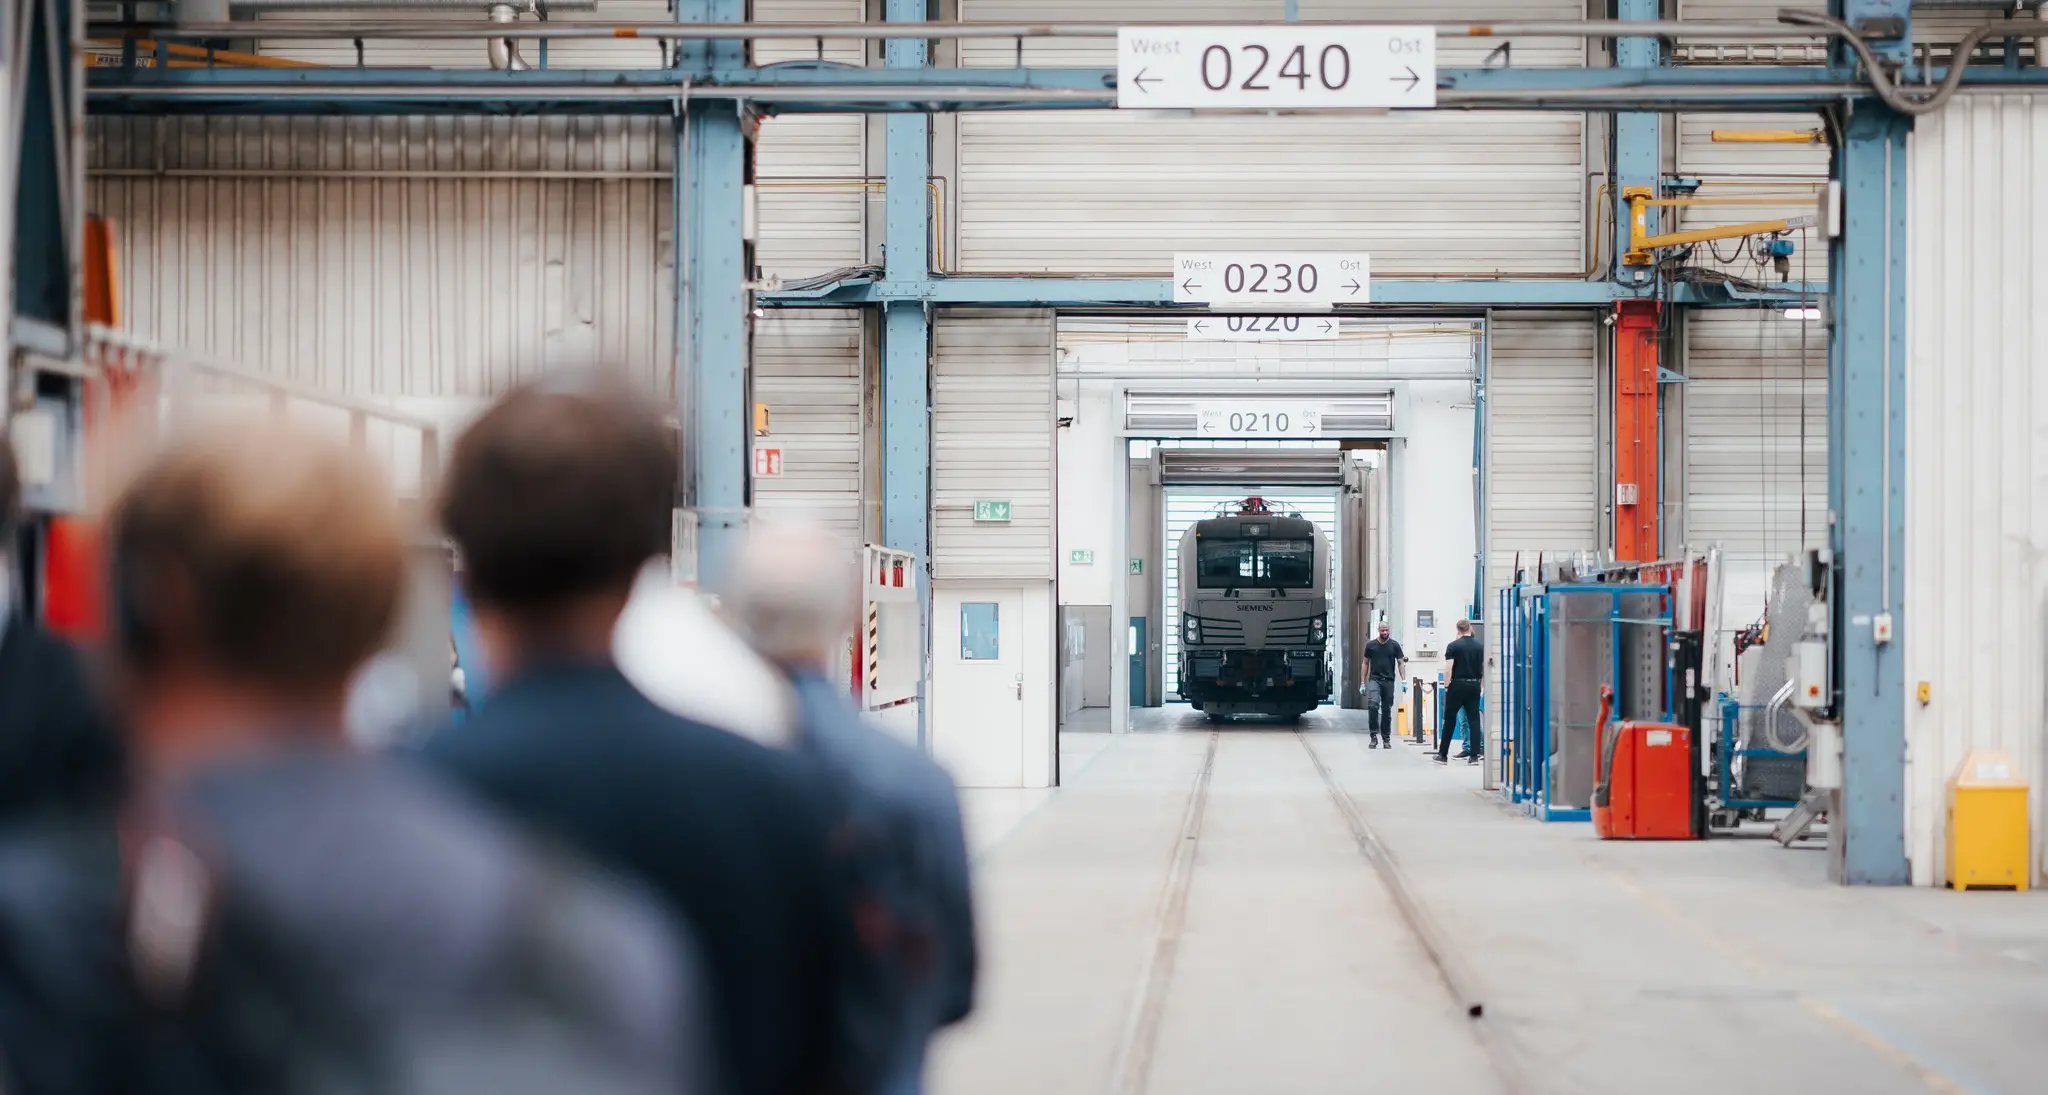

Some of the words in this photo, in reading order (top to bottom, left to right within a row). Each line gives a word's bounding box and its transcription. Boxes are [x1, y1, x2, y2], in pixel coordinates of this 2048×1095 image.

[1388, 36, 1421, 54] Ost
[1201, 44, 1350, 91] 0240
[1181, 259, 1212, 270] West
[1340, 259, 1361, 270] Ost
[1224, 263, 1318, 293] 0230
[1229, 412, 1289, 432] 0210
